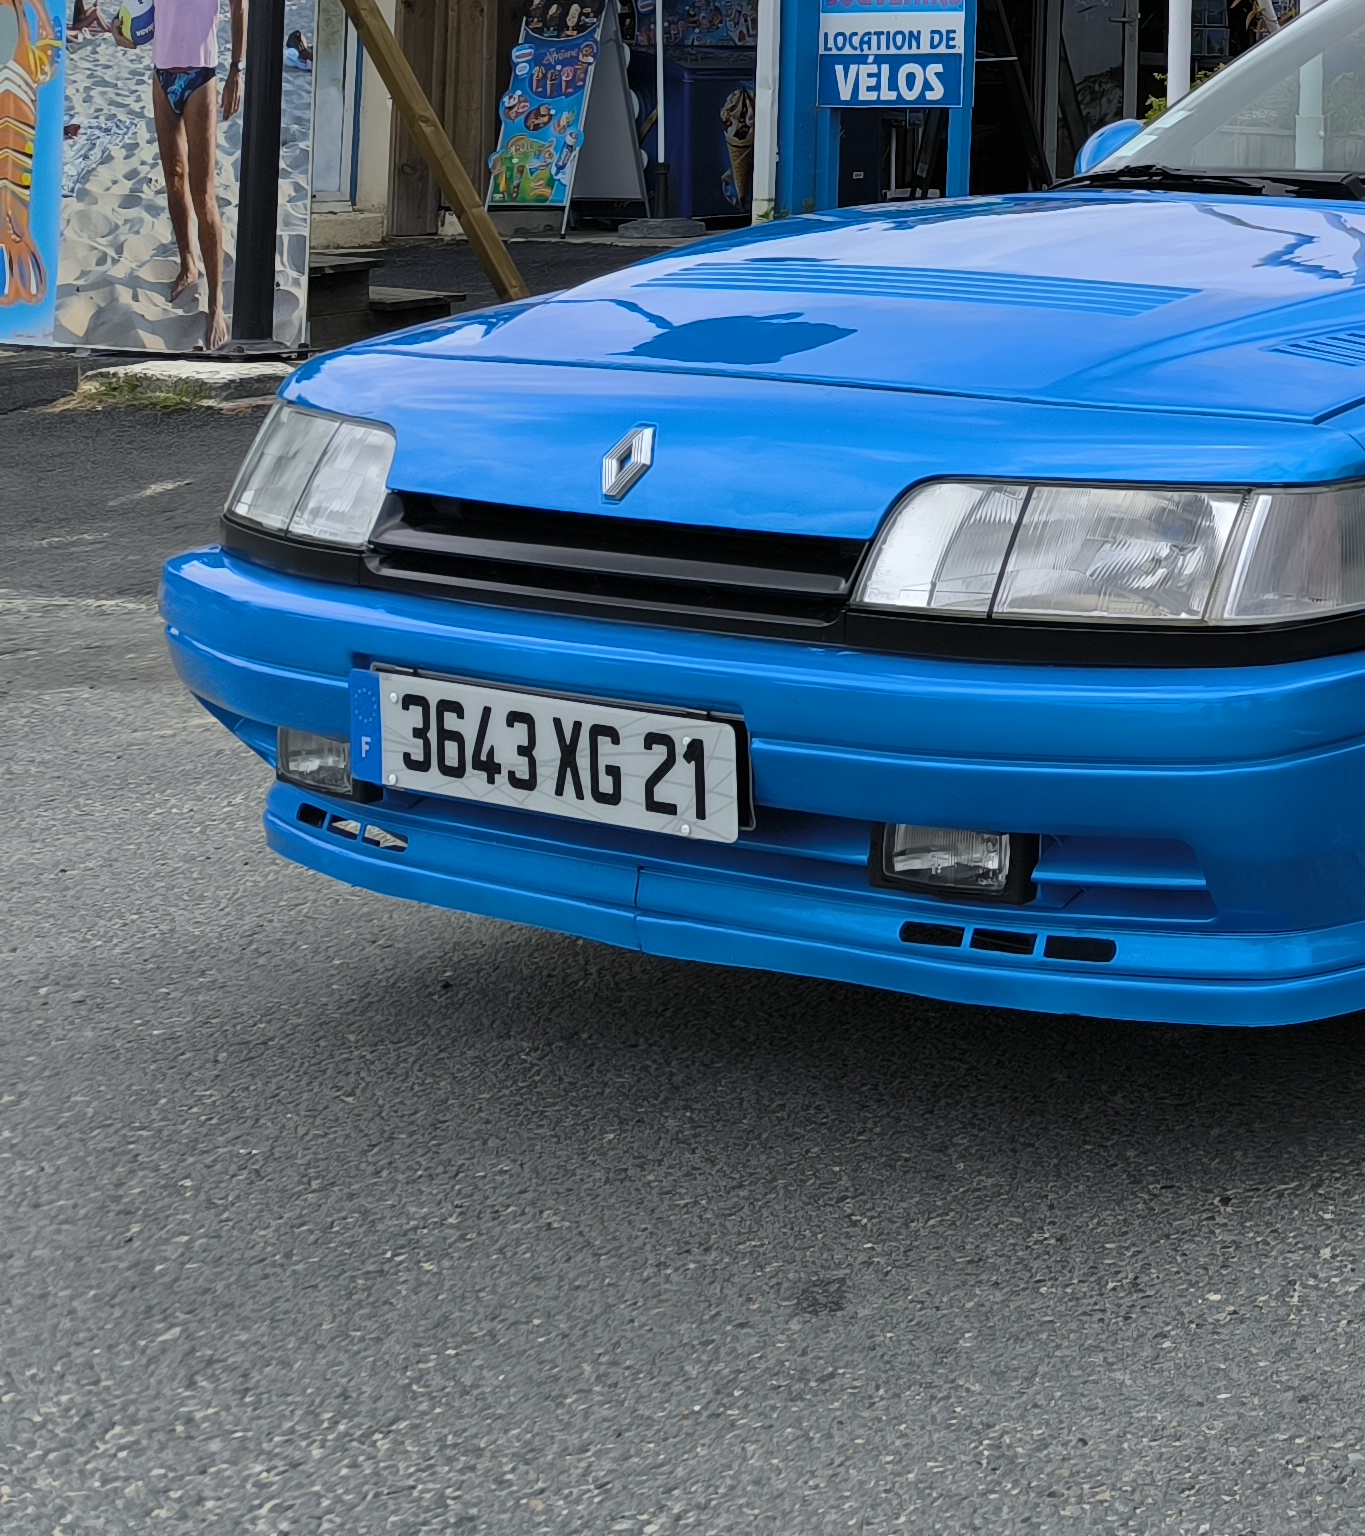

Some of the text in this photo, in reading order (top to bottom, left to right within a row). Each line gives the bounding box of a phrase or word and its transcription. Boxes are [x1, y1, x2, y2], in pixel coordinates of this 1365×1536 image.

[823, 29, 957, 53] LOCATION DE
[834, 55, 945, 101] VÉLOS
[360, 736, 371, 758] F
[401, 693, 707, 821] 3643 XG 21
